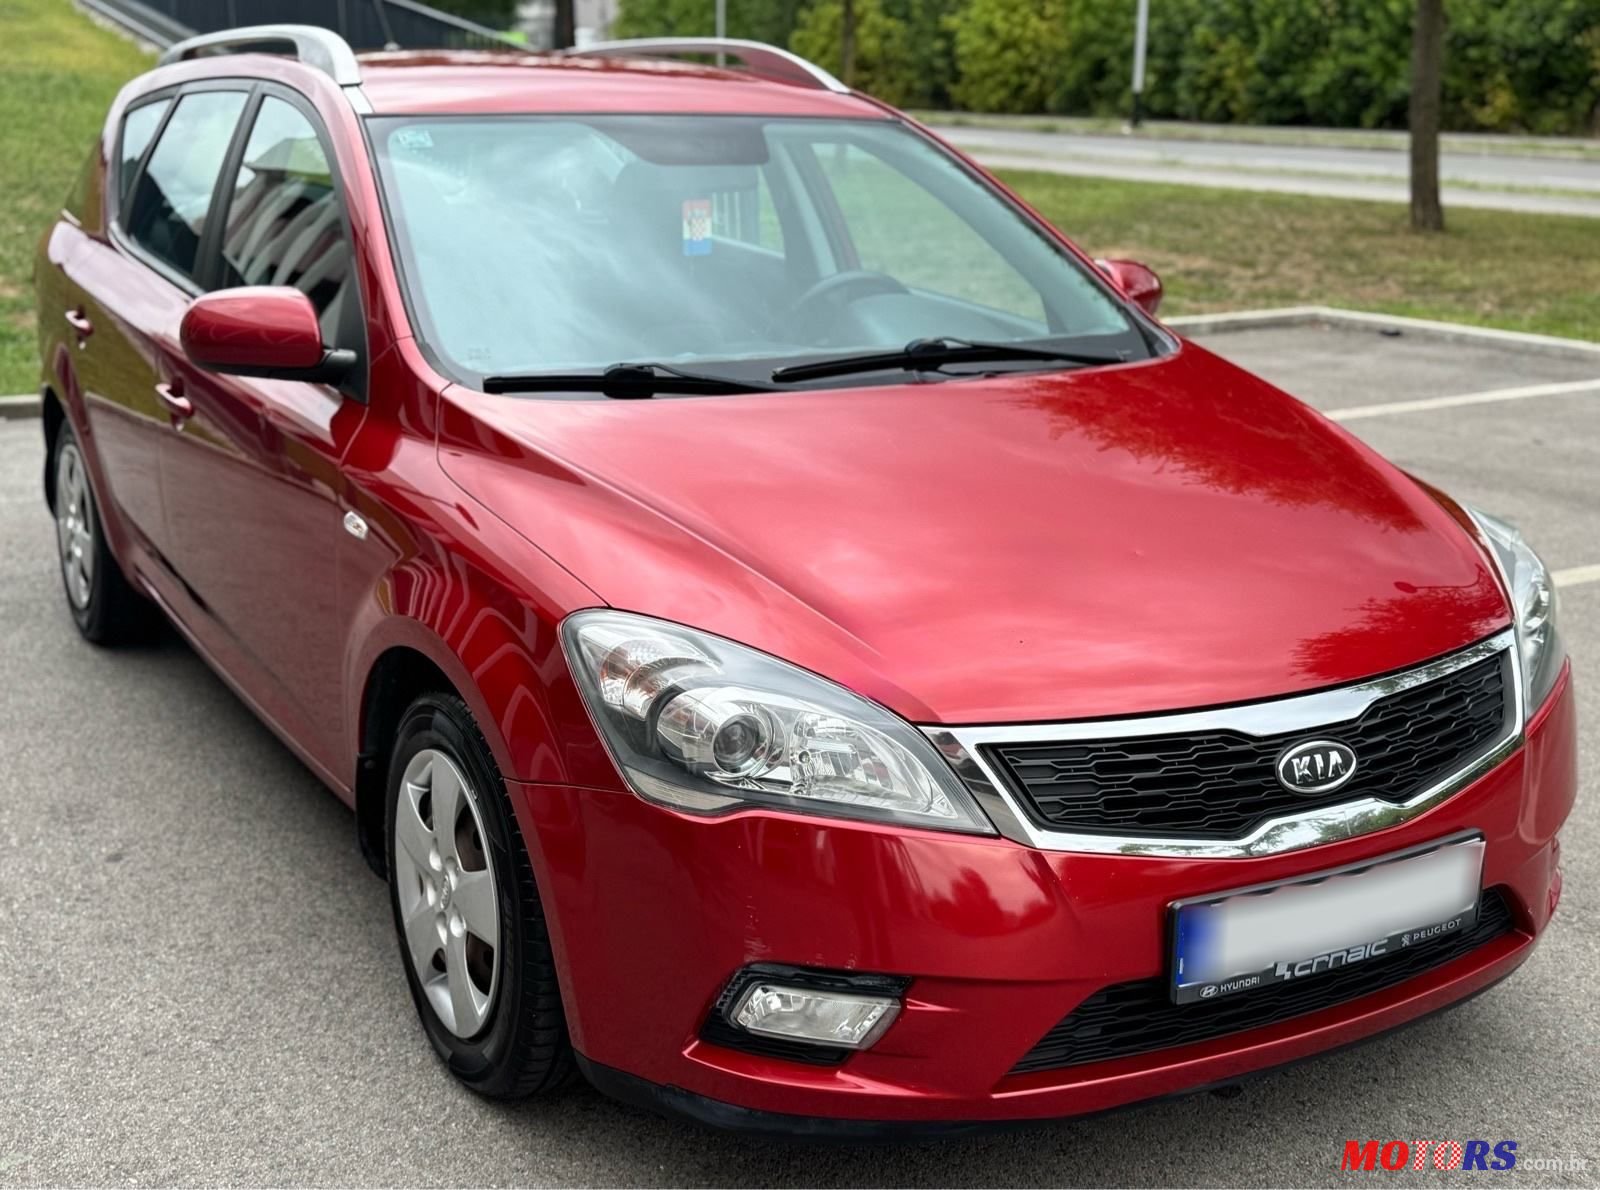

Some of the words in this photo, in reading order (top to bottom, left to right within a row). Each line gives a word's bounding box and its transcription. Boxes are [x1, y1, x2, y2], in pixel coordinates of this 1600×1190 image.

[1291, 750, 1346, 784] KIA
[1220, 976, 1261, 993] HYUNDAI
[1413, 918, 1462, 941] PEUGEOT
